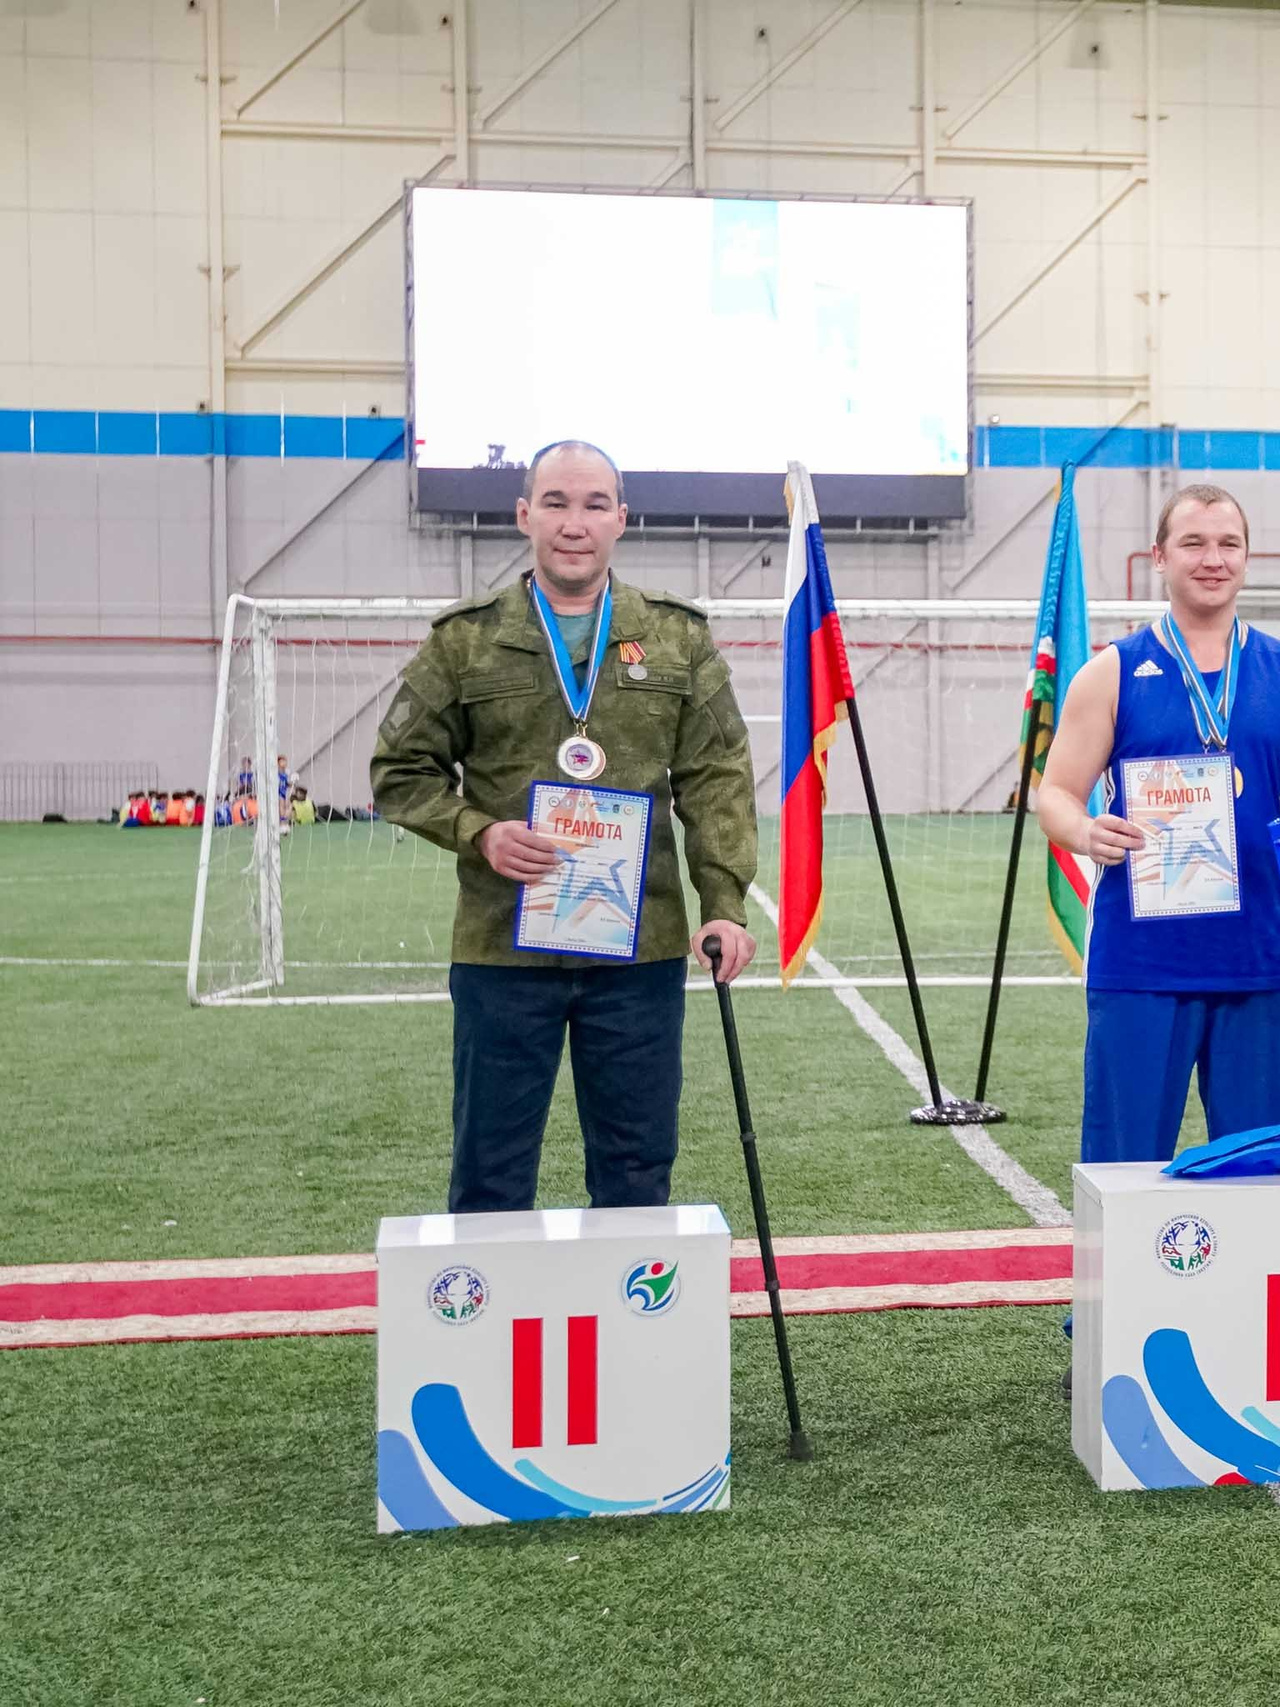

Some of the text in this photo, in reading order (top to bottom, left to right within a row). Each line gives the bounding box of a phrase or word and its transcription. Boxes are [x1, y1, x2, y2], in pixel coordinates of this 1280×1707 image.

[1147, 786, 1212, 806] ГРАМОТА
[554, 817, 623, 841] ГРАМОТА
[512, 1316, 598, 1449] II
